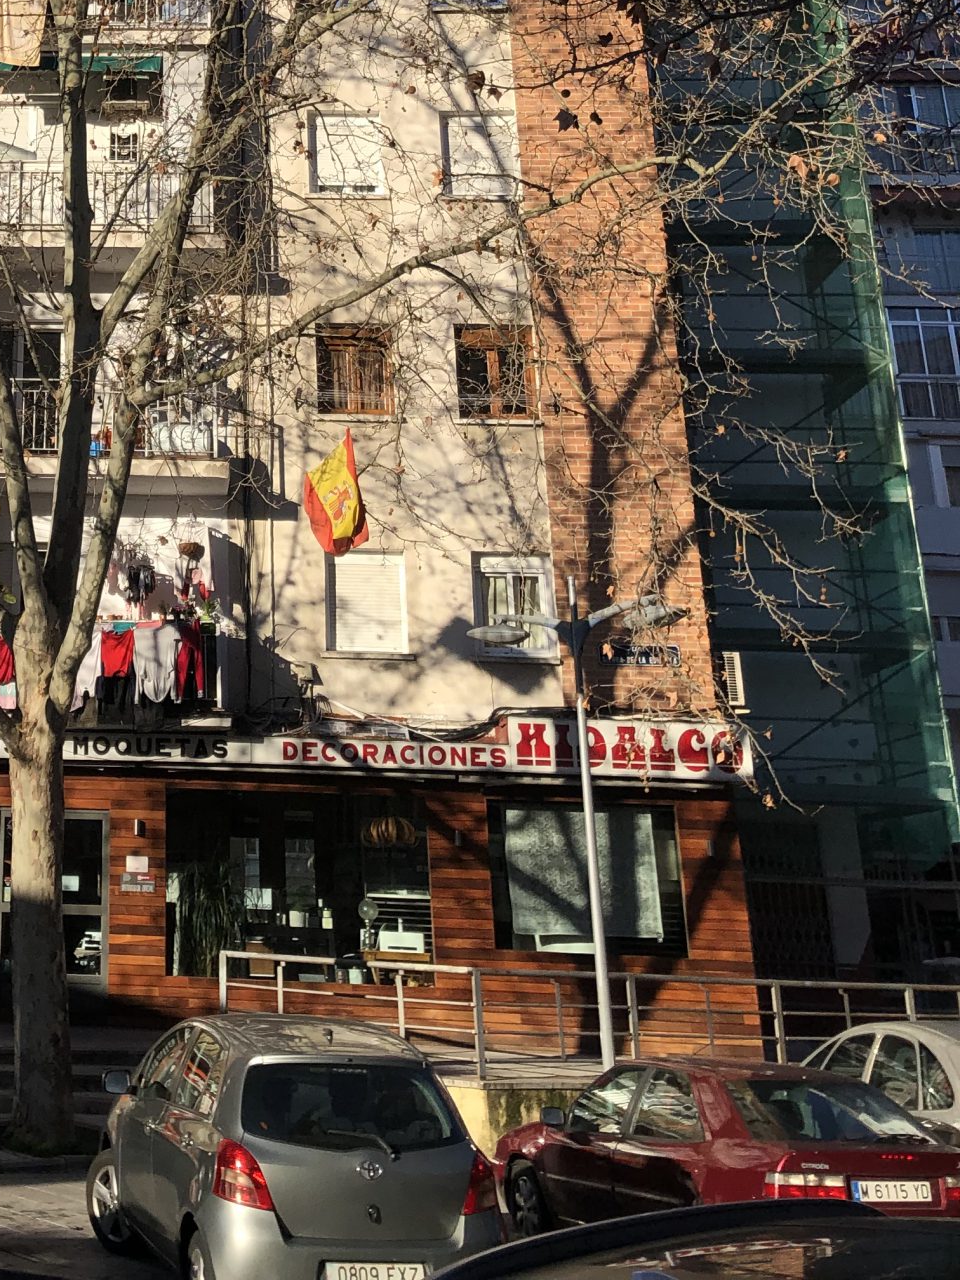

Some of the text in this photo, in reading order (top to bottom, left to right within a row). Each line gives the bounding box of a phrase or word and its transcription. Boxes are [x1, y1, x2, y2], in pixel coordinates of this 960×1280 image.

[72, 735, 230, 759] MOQUETAS
[282, 741, 507, 767] DECORACIONES
[516, 722, 744, 775] HIDALGO
[874, 1183, 909, 1198] 6115
[914, 1183, 930, 1200] YD
